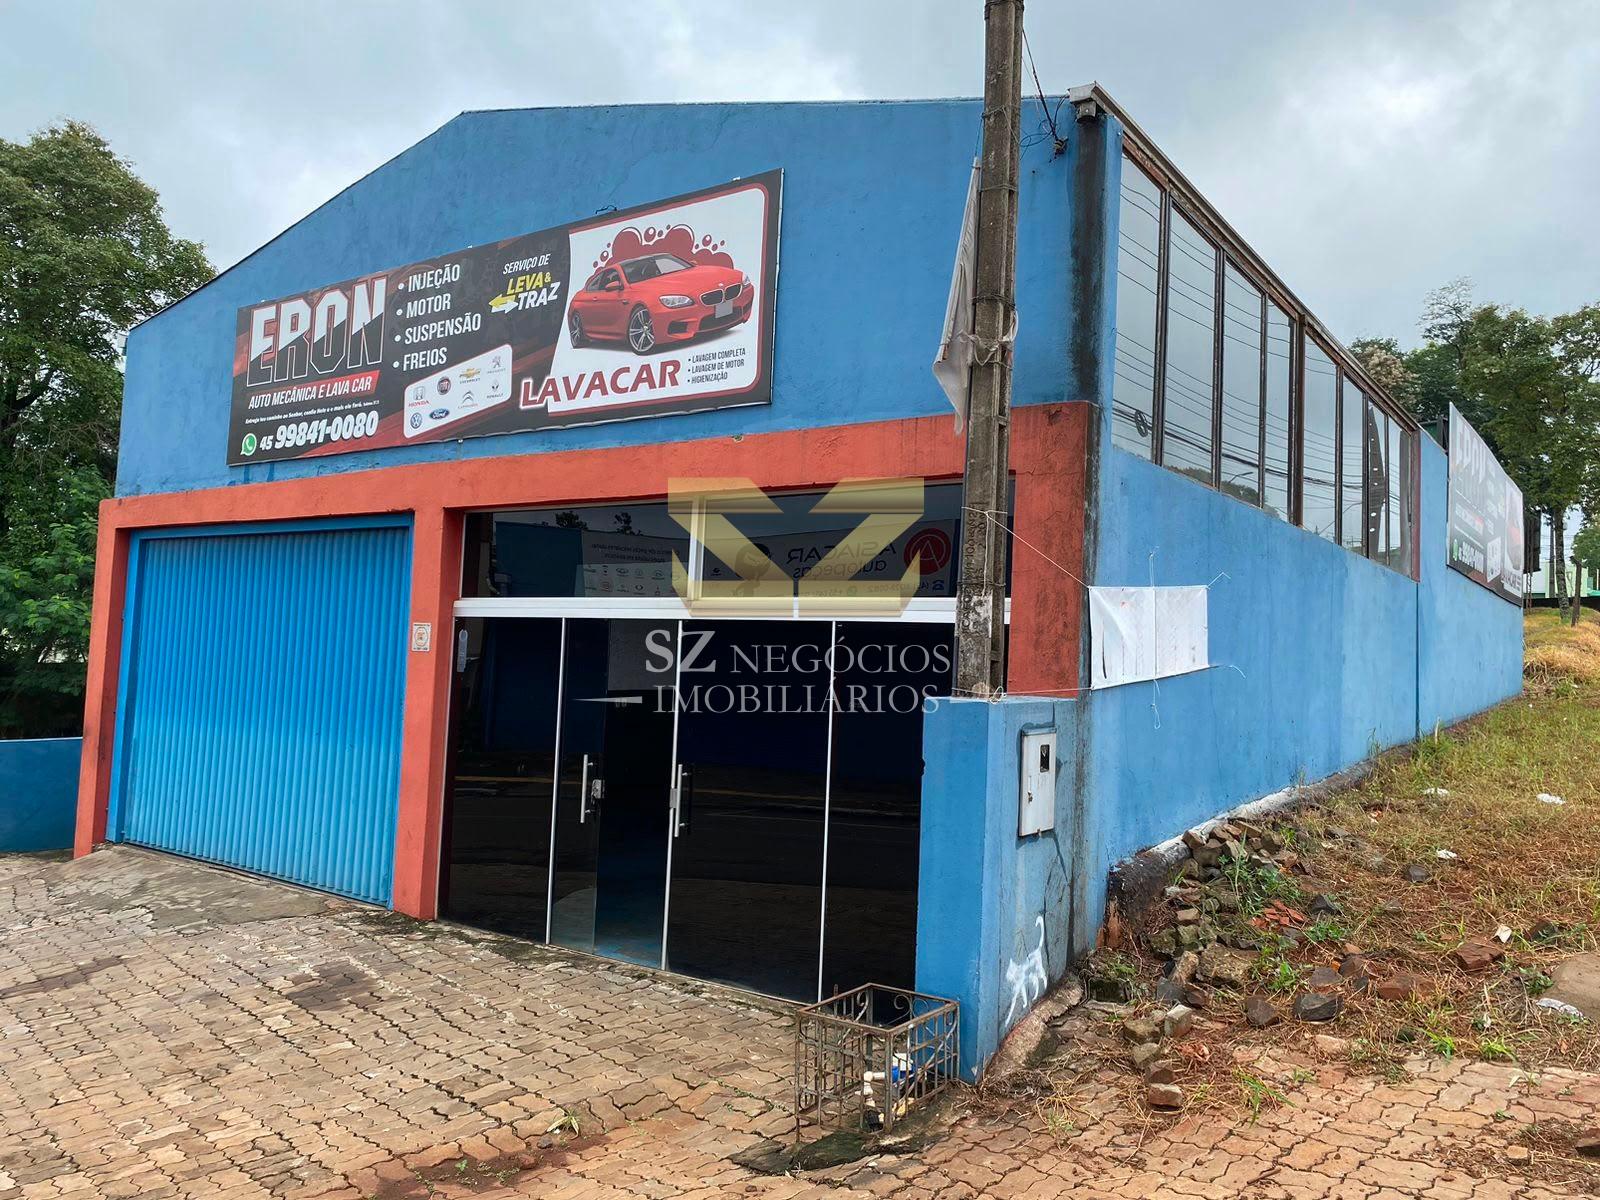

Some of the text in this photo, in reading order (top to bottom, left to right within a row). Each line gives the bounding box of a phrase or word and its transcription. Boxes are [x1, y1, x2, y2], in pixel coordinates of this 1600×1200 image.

[408, 263, 461, 292] INJEÇÃO
[503, 254, 551, 275] SERVIÇO DE
[406, 293, 451, 318] MOTOR
[517, 282, 561, 310] TRAZ
[247, 277, 387, 387] ERON
[404, 312, 481, 344] SUSPENSÃO
[403, 347, 448, 371] FREIOS
[691, 359, 745, 373] LAVAGEM DE MOTOR
[692, 348, 746, 363] LAVAGEM COMPLETA
[521, 359, 681, 407] LAVACAR
[691, 371, 728, 384] HIGIENIZAÇÃO
[248, 375, 373, 409] AUTO MECÂNICA E LAVA CAR
[260, 410, 379, 450] 45 99841-0080
